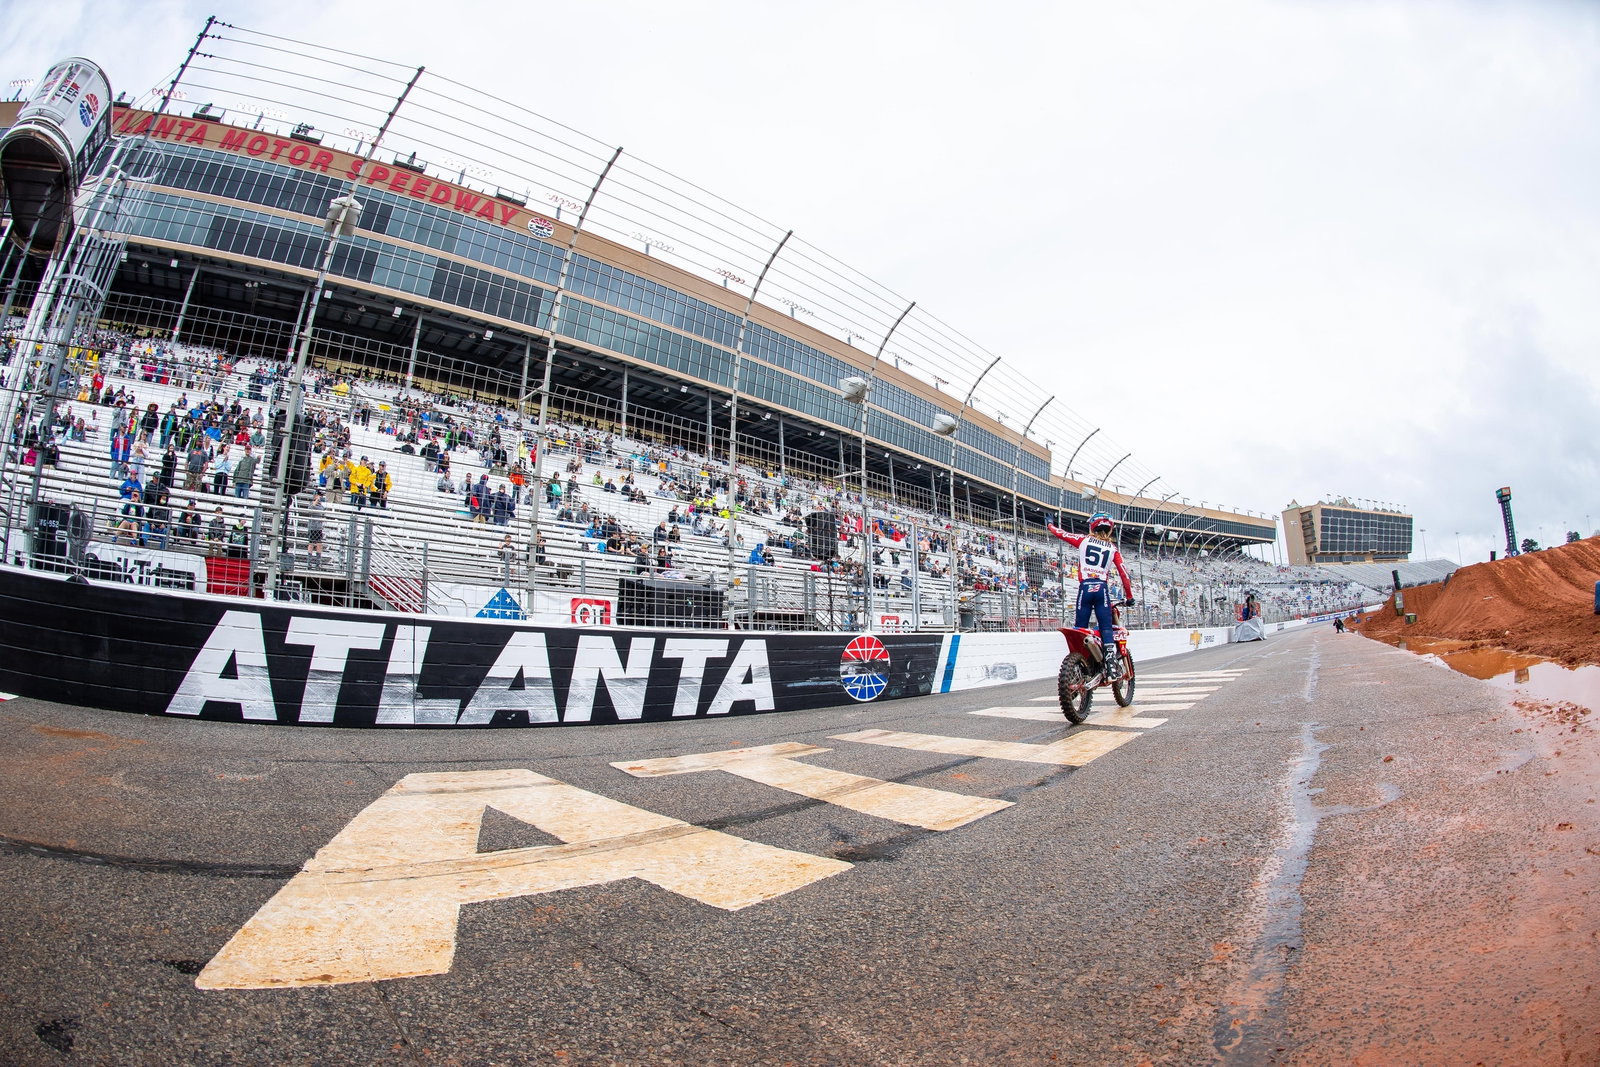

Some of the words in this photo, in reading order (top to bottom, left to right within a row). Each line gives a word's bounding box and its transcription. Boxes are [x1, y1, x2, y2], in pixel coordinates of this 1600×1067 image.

[112, 110, 209, 145] TLANTA
[218, 129, 334, 173] MOTOR
[346, 159, 520, 227] SPEEDWAY
[1085, 544, 1111, 569] 51
[574, 602, 606, 626] QT
[165, 610, 776, 726] ATLANTA
